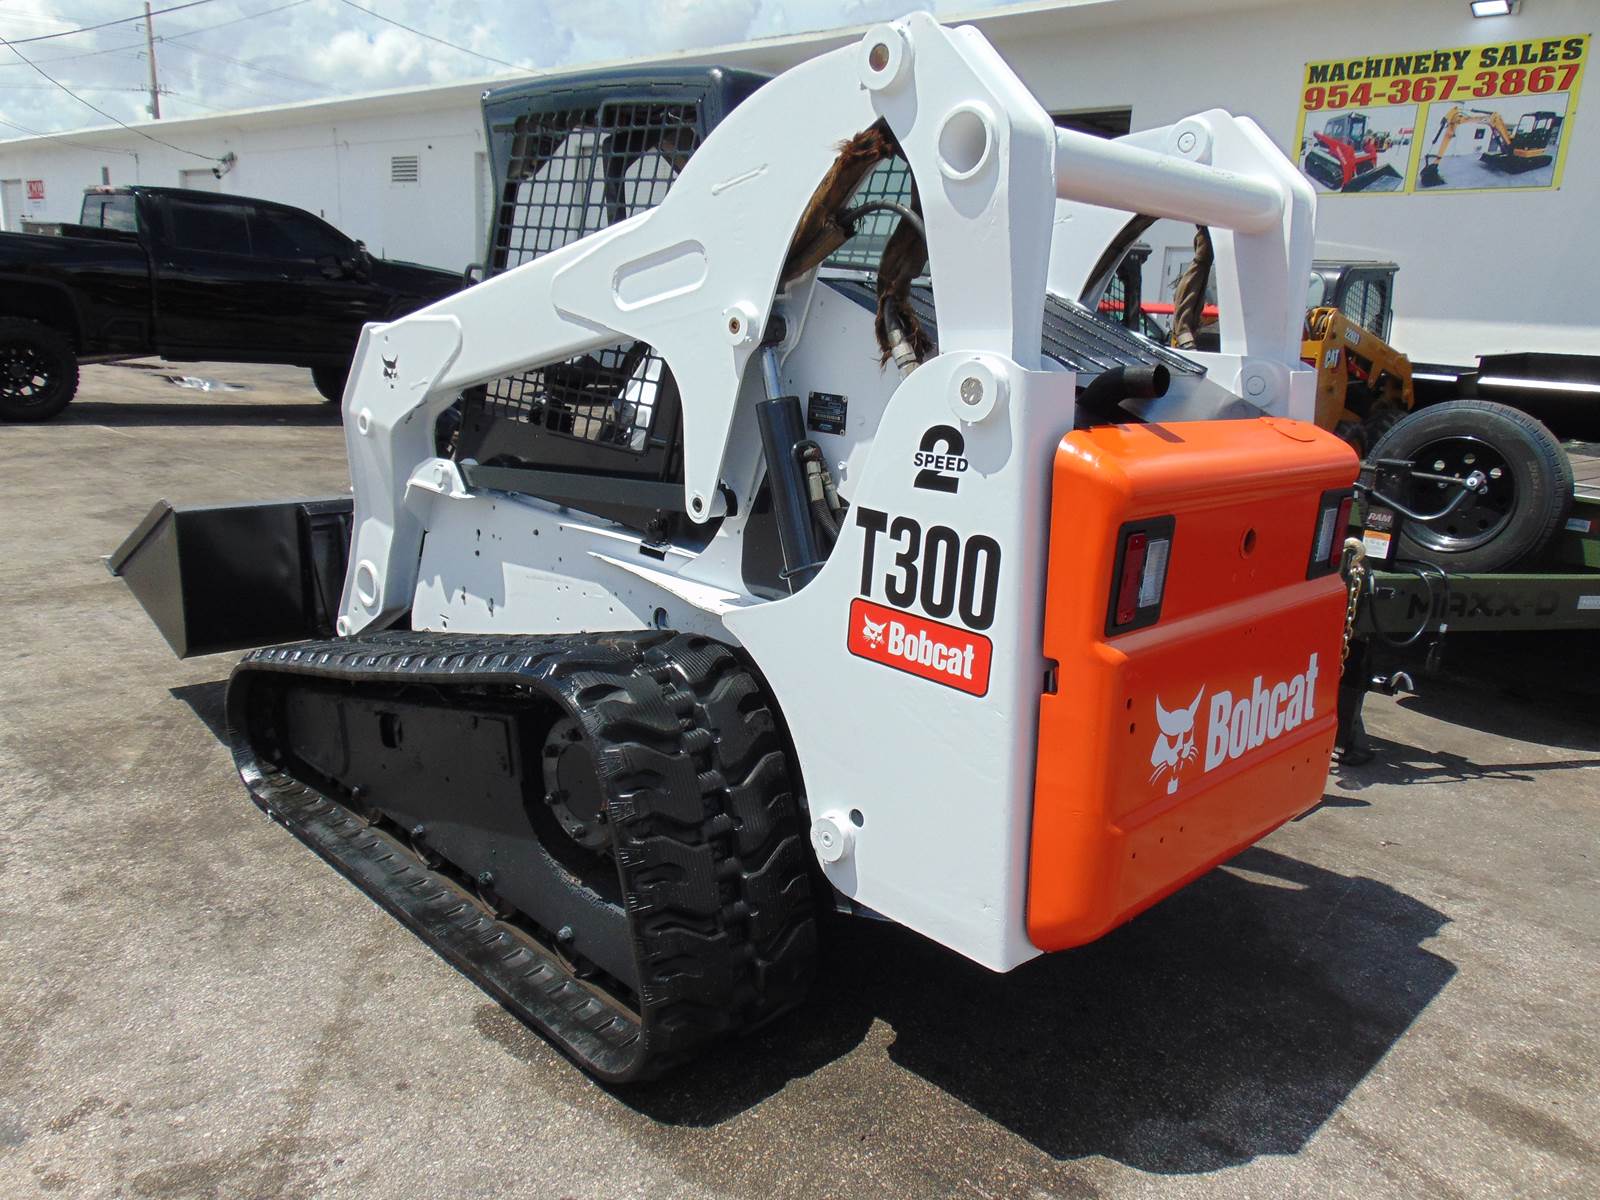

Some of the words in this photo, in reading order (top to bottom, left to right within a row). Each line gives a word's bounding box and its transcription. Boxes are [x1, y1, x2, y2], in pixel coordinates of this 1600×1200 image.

[1304, 64, 1580, 110] 954-367-3867
[1308, 50, 1471, 84] MACHINERY
[1479, 38, 1584, 68] SALES
[913, 452, 969, 473] SPEED
[856, 506, 1002, 631] T300
[888, 621, 975, 680] Bobcat
[1204, 652, 1319, 773] Bobcat
